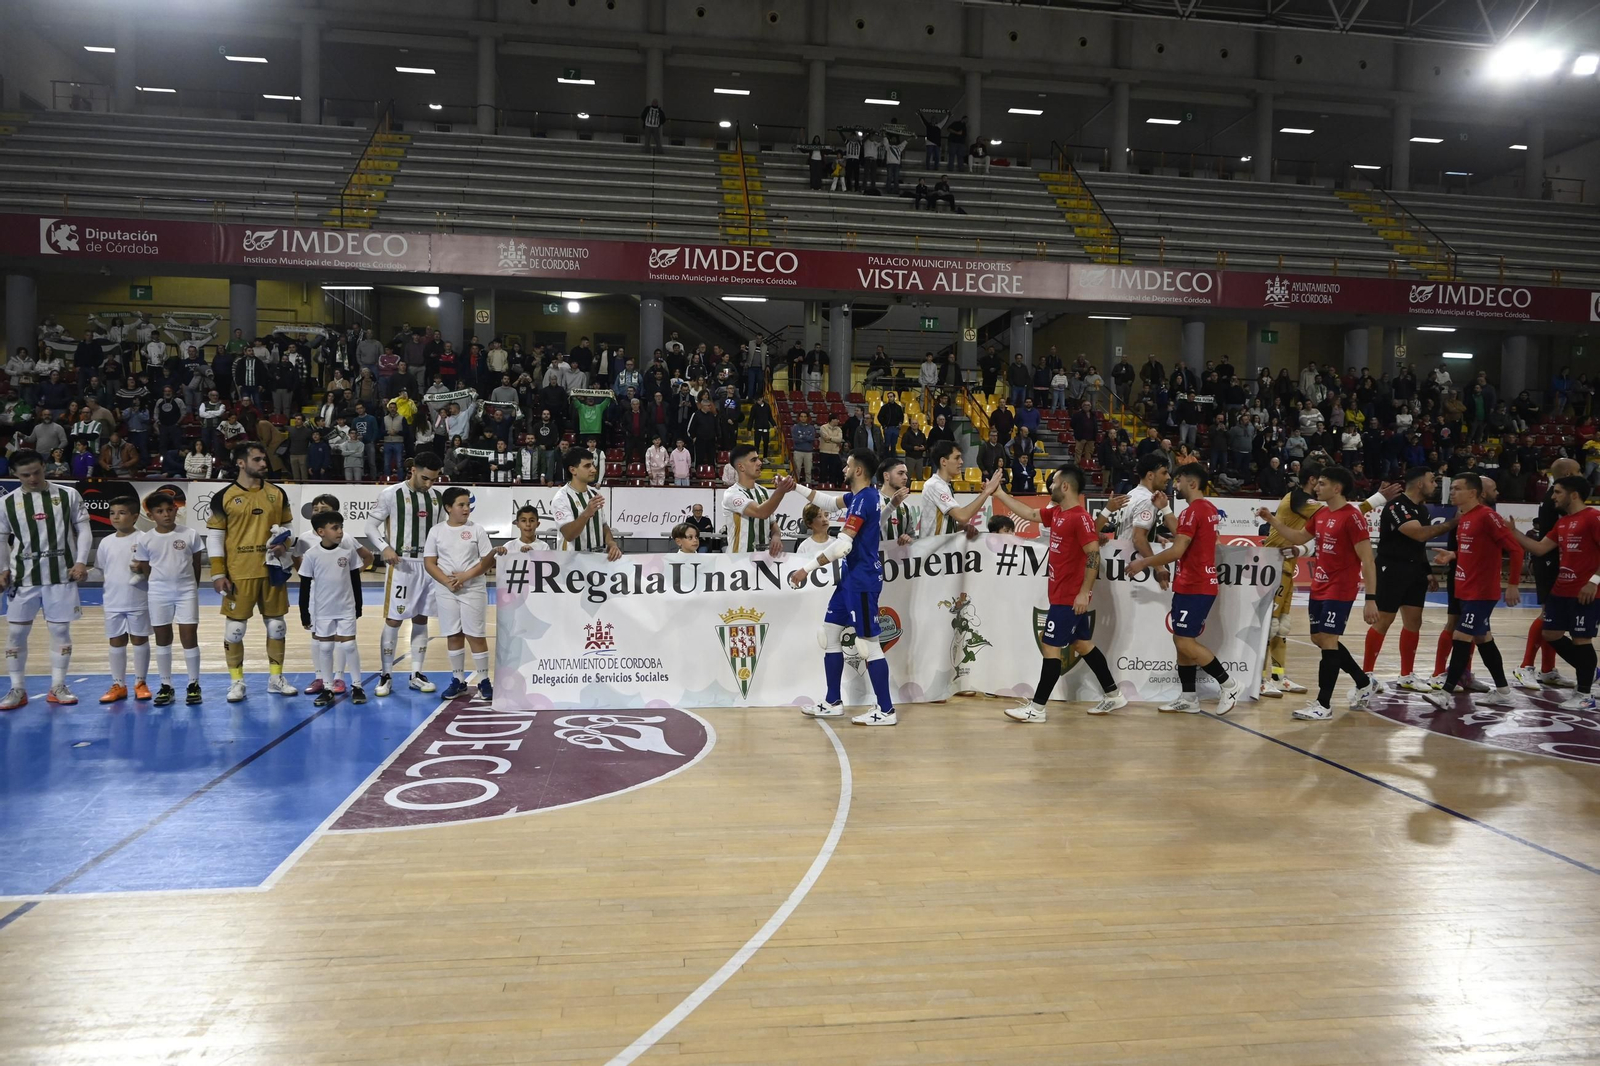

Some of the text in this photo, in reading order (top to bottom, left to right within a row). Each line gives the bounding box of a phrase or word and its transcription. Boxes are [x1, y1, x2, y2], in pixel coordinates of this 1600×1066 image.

[218, 46, 226, 54] 6
[569, 70, 576, 78] 7
[890, 91, 898, 100] 8
[1186, 112, 1192, 121] 9
[85, 228, 158, 242] Diputación
[86, 242, 159, 255] de Córdoba
[282, 229, 408, 257] IMDECO
[530, 246, 589, 258] AYUNTAMIENTO
[243, 256, 278, 264] Instituto
[279, 257, 320, 267] Municipal
[334, 260, 371, 269] Deportes
[372, 260, 407, 270] Córdoba
[530, 258, 580, 270] DE CÓRDOBA
[684, 248, 798, 274] IMDECO
[868, 256, 1012, 272] PALACIO MUNICIPAL DEPORTES
[649, 272, 680, 280] Instituto
[682, 274, 718, 283] Municipal
[731, 276, 764, 284] Deportes
[766, 278, 797, 286] Córdoba
[857, 268, 1024, 294] VISTA ALEGRE
[1110, 268, 1212, 292] IMDECO
[136, 288, 145, 298] F
[1292, 282, 1340, 294] AYUNTAMIENTO
[1184, 296, 1212, 304] Córdoba
[1291, 292, 1333, 304] DE CÓRDOBA
[1438, 284, 1531, 308] IMDECO
[549, 302, 558, 312] G
[1436, 308, 1466, 316] Municipal
[1476, 310, 1504, 318] Deportes
[1504, 310, 1530, 318] Córdoba
[926, 319, 933, 328] H
[1576, 346, 1582, 356] J
[350, 502, 377, 510] RUIZ
[616, 510, 658, 524] Ángela
[506, 551, 982, 603] #RegalaUnaNochbuena
[396, 585, 407, 599] 21
[850, 610, 856, 622] 1
[1180, 610, 1188, 622] 7
[1326, 611, 1336, 623] 22
[1464, 613, 1474, 624] 13
[1576, 616, 1585, 626] 14
[1047, 620, 1055, 632] 9
[538, 658, 663, 670] AYUNTAMIENTO DE CORDOBA
[1117, 656, 1172, 672] Cabezas
[532, 672, 669, 686] Delegación de Servicios Sociales
